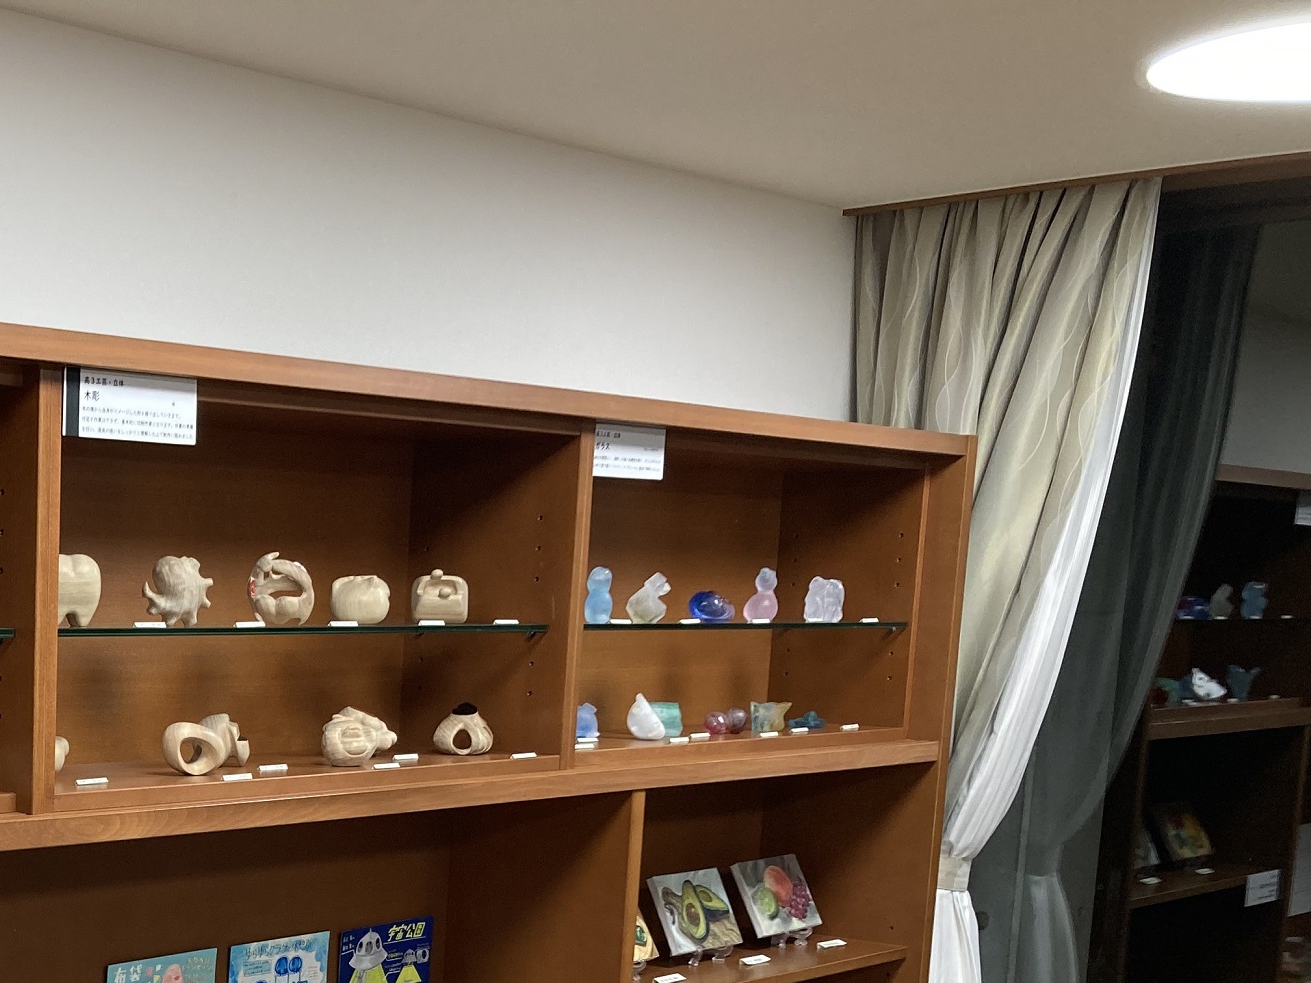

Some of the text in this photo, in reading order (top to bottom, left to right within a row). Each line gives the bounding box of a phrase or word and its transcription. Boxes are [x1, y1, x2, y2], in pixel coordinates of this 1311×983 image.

[84, 389, 100, 401] 木彫
[387, 922, 426, 941] 宇宙公園
